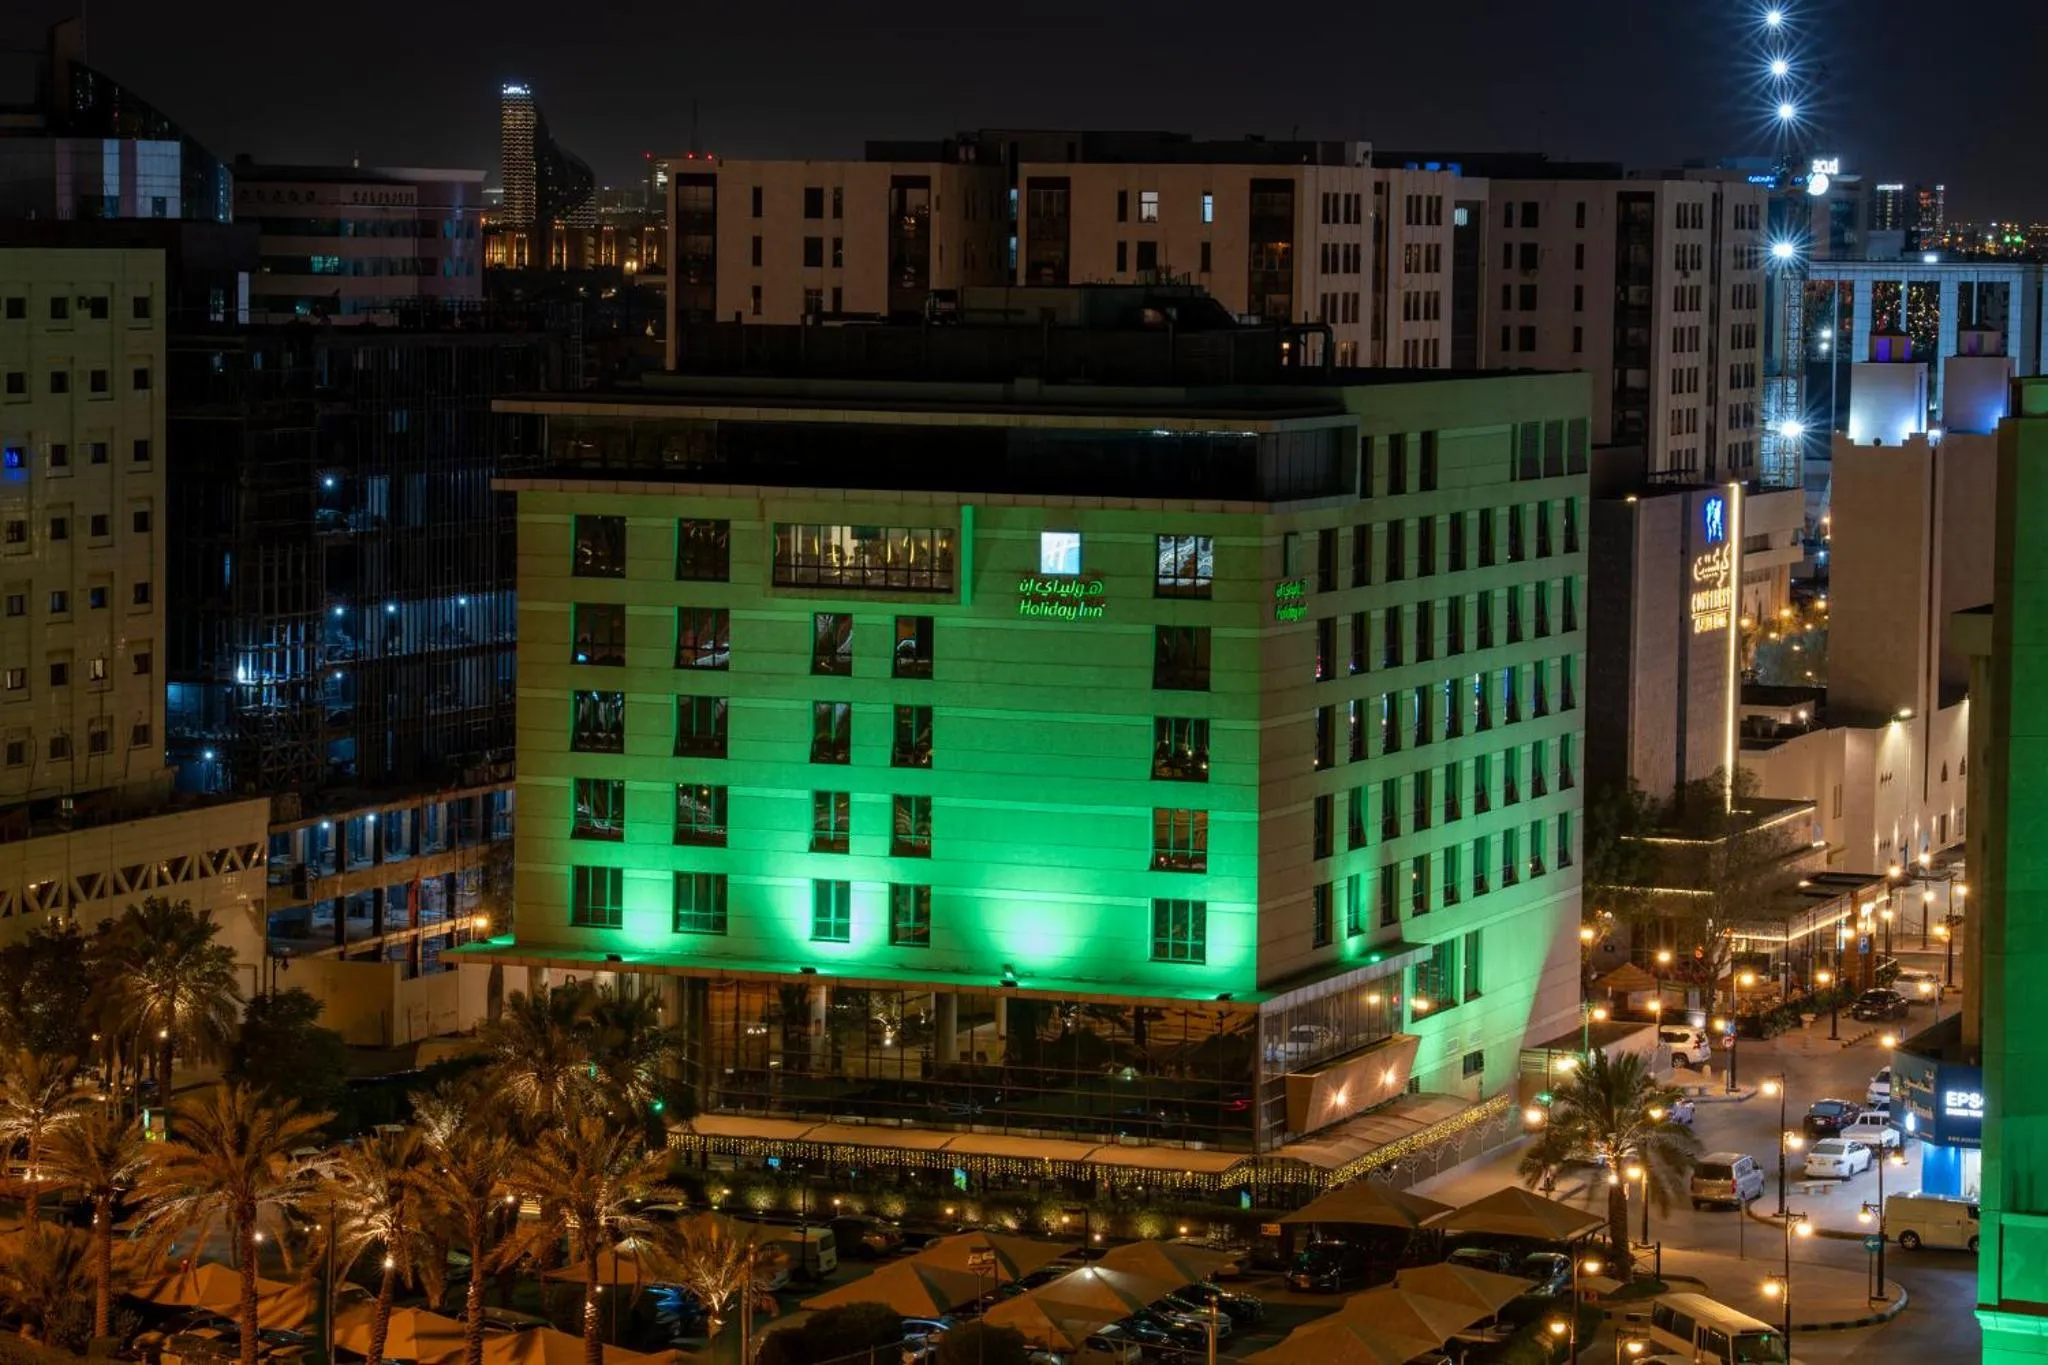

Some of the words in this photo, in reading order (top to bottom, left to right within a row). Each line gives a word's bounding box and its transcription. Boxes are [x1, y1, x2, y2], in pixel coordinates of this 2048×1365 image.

[1020, 600, 1078, 620] Holiday
[1079, 601, 1103, 617] Inn
[1946, 1091, 1984, 1109] EPS
